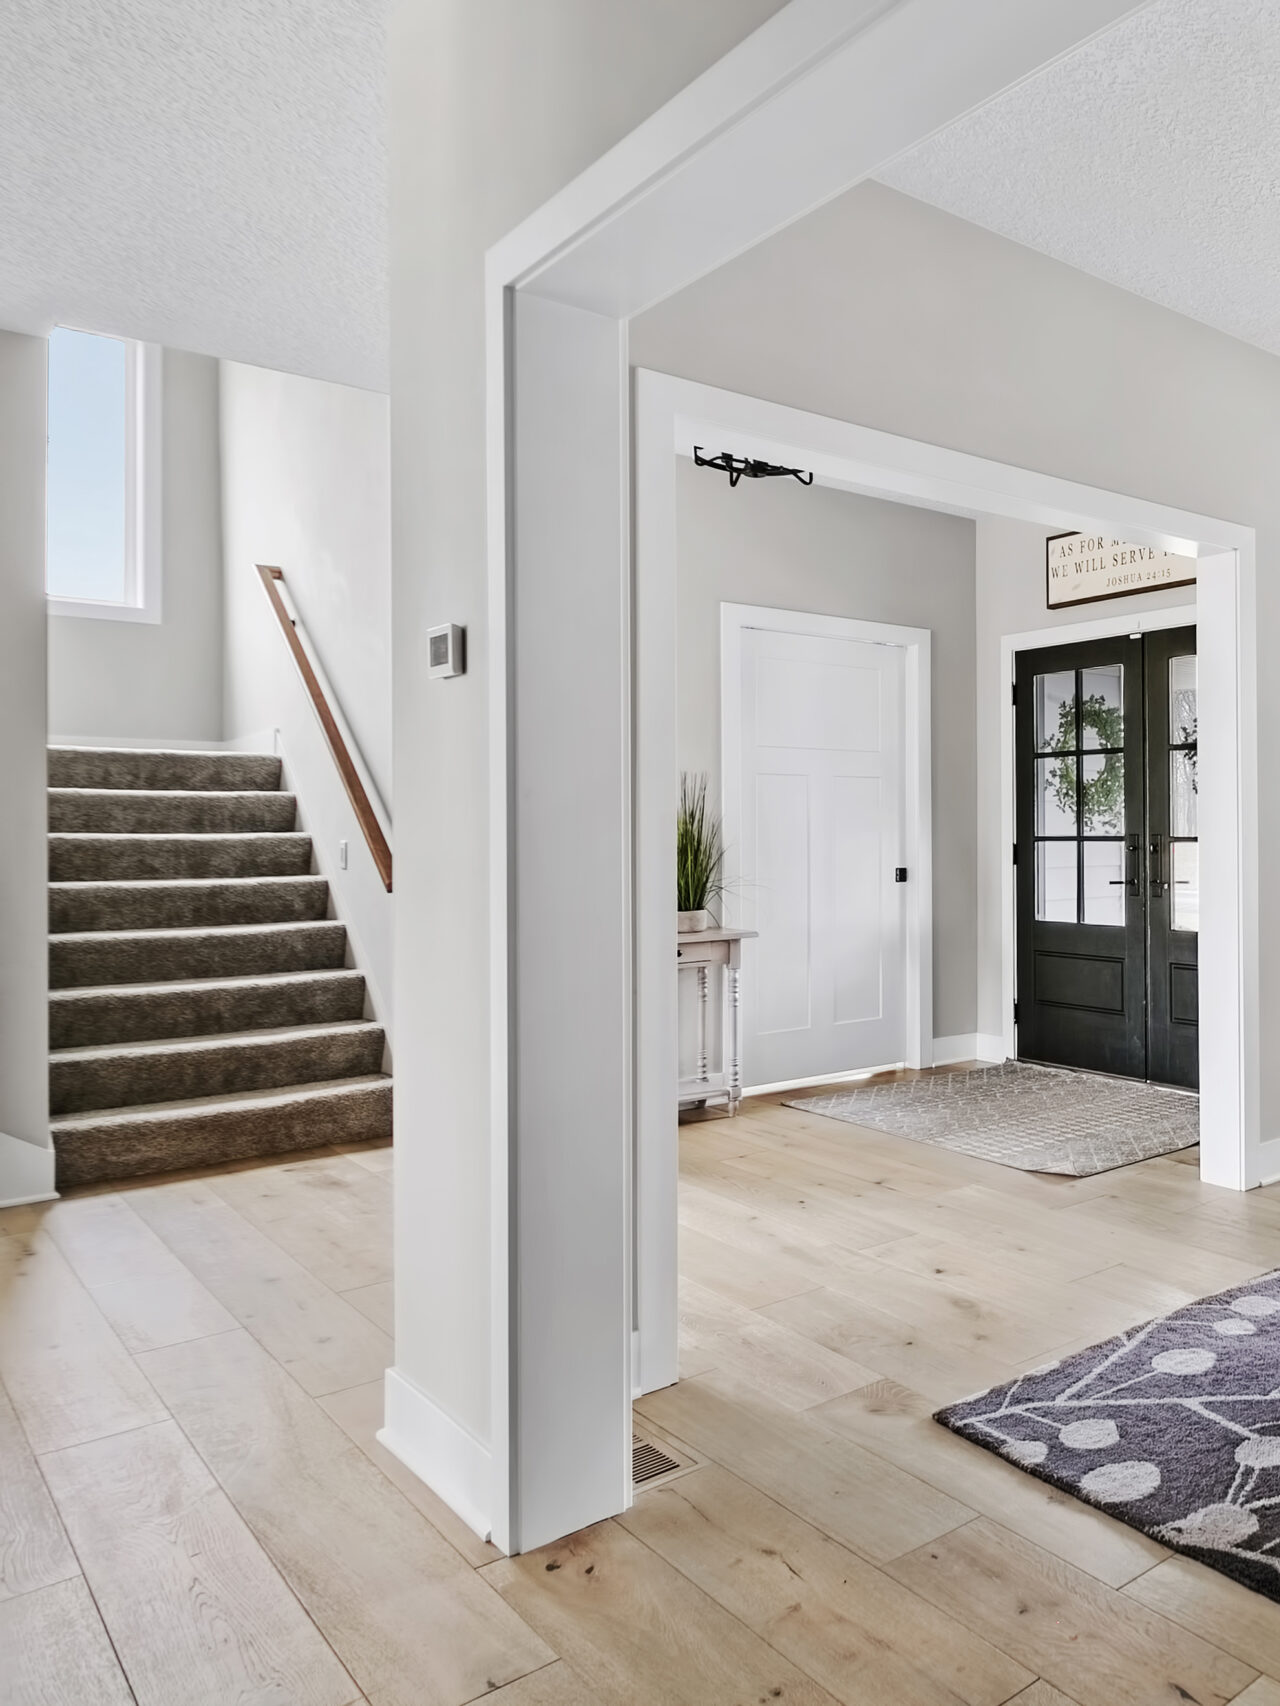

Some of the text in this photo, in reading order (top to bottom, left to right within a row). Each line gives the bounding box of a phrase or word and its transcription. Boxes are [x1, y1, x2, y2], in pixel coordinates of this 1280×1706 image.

[1059, 543, 1073, 558] AS
[1080, 536, 1104, 554] FOR
[1051, 547, 1155, 579] WE WILL SERVE
[1106, 568, 1171, 587] JOSHUA 24:15
